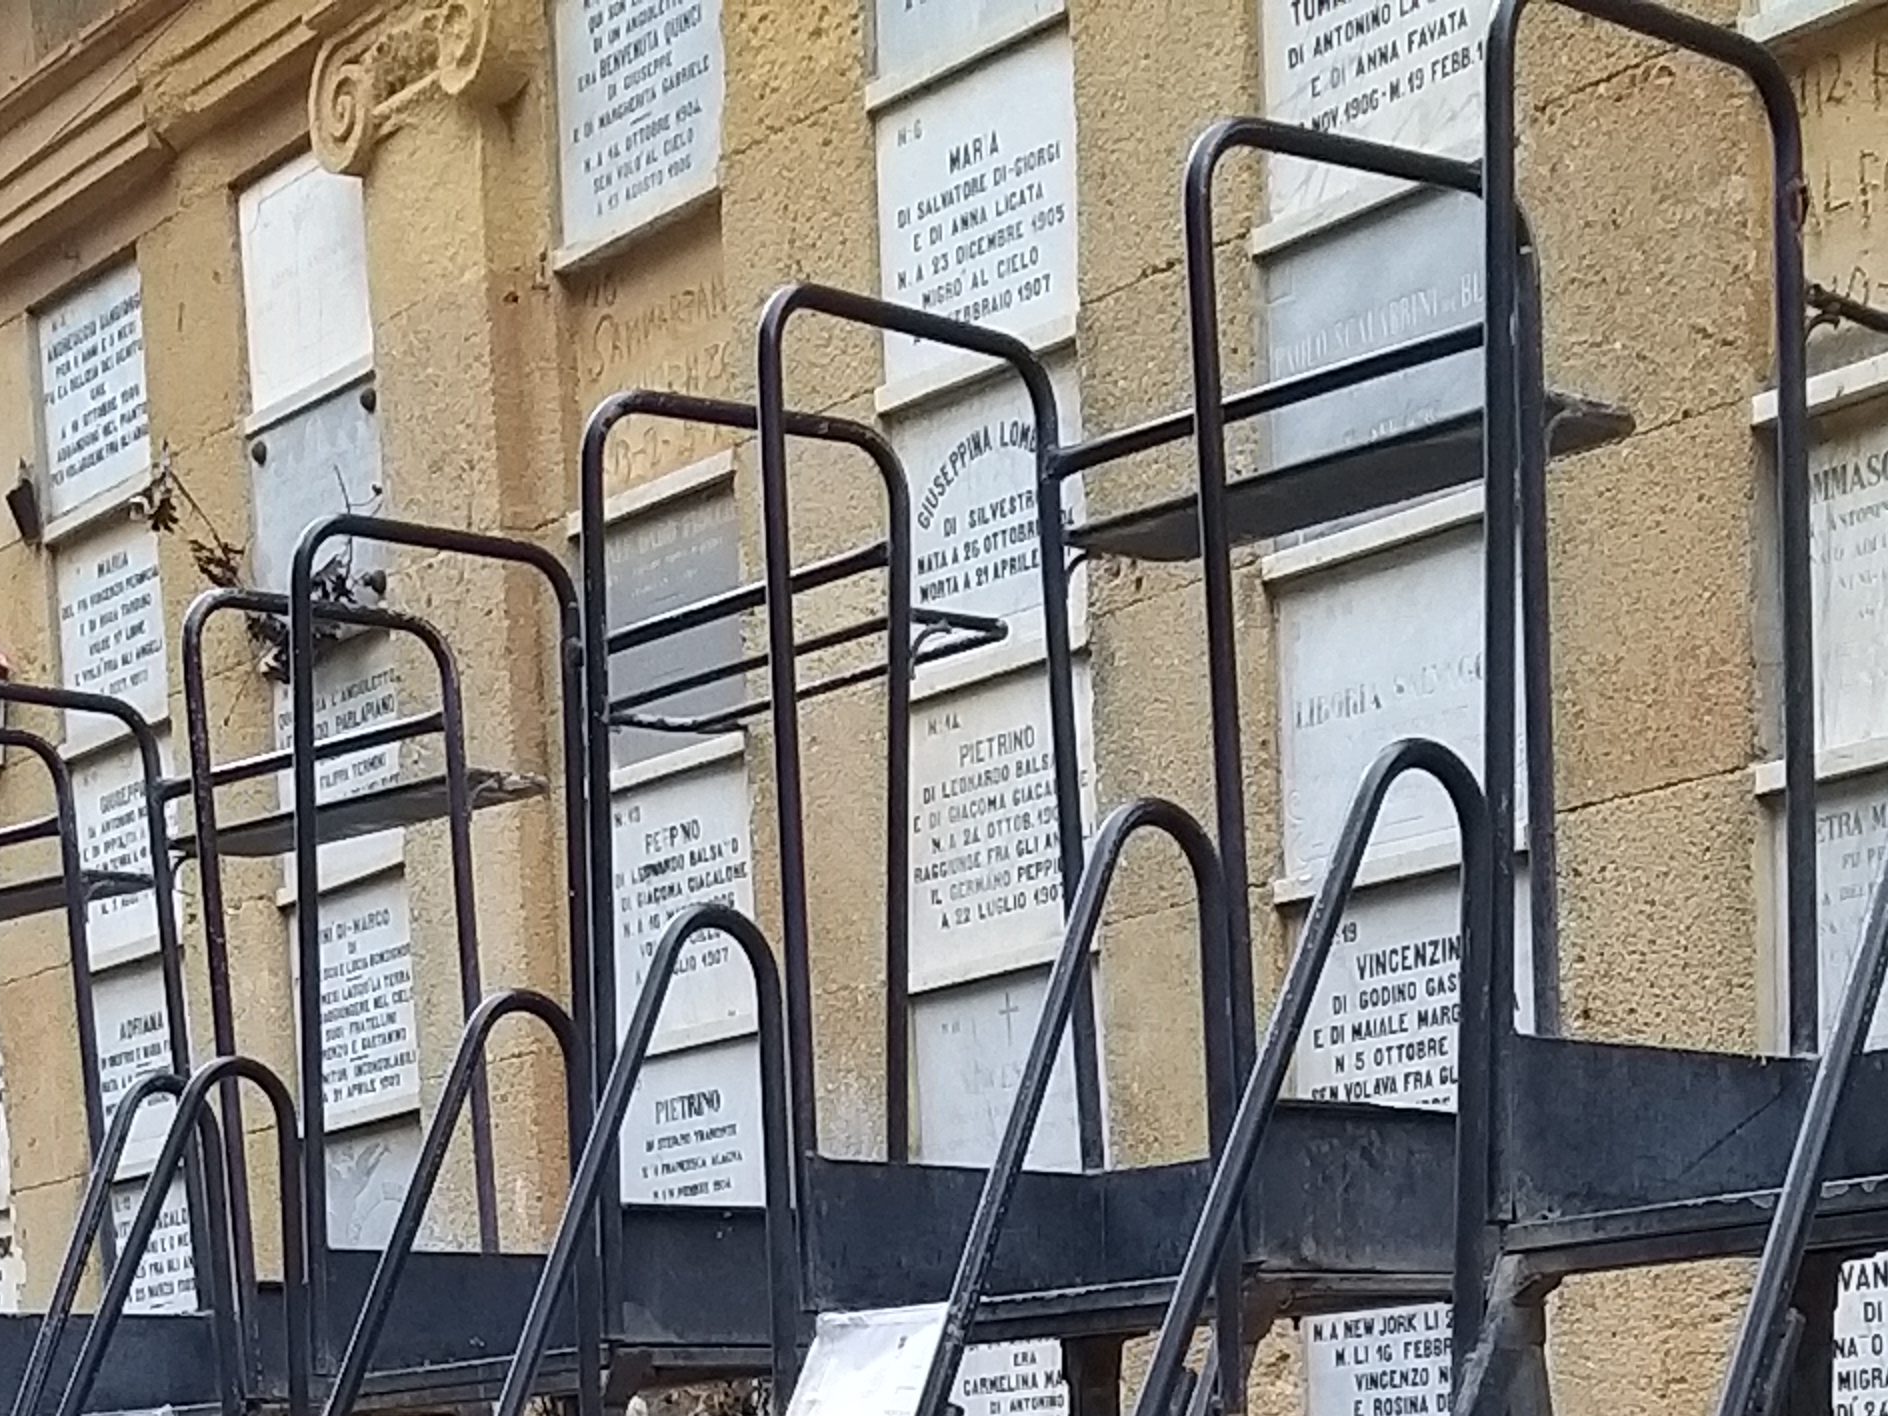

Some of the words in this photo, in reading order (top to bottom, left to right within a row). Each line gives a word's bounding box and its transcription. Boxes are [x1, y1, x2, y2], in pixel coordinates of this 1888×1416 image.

[1288, 48, 1304, 69] DI
[1313, 3, 1391, 58] ANTONINO
[1312, 76, 1321, 97] E
[1331, 67, 1346, 88] DI
[1356, 41, 1400, 77] ANNA
[1407, 8, 1468, 53] FAVATA
[1408, 68, 1424, 93] 19
[1430, 50, 1474, 81] FEBB.
[897, 208, 910, 228] DI
[917, 174, 986, 220] SALVATORE
[930, 225, 943, 245] DI
[951, 208, 987, 236] ANNA
[956, 221, 1024, 264] DICEMBRE
[970, 271, 988, 290] AL
[997, 246, 1039, 279] CIELO
[917, 426, 992, 530] GIUSEPPINA
[943, 518, 956, 537] DI
[968, 490, 1037, 529] SILVESTR
[918, 550, 948, 575] NATA
[920, 575, 959, 603] MORTA
[992, 549, 1039, 581] APRILE
[960, 726, 1035, 768] PIETRINO
[923, 787, 934, 804] DI
[942, 764, 1010, 799] LEONARDO
[930, 812, 941, 829] DI
[948, 794, 1006, 824] GIACOMA
[690, 838, 738, 866] BALSAO
[987, 845, 1010, 864] FRA
[1016, 838, 1038, 858] GLI
[978, 892, 1026, 919] LUGLIO
[1333, 995, 1347, 1015] DI
[1359, 981, 1416, 1009] GODINO
[1314, 1029, 1323, 1049] E
[1330, 1025, 1344, 1043] DI
[1352, 1013, 1408, 1041] MAIALE
[1356, 1051, 1364, 1070] 5
[1373, 1037, 1448, 1065] OTTOBRE
[1404, 1070, 1432, 1092] FRA
[1344, 1319, 1375, 1339] NEW
[1380, 1313, 1416, 1336] JORK
[1424, 1311, 1439, 1330] LI
[1864, 1301, 1883, 1322] DI
[964, 1371, 1038, 1396] CARMELINA
[1355, 1368, 1429, 1392] VINCENZO
[1373, 1394, 1428, 1416] ROSINA
